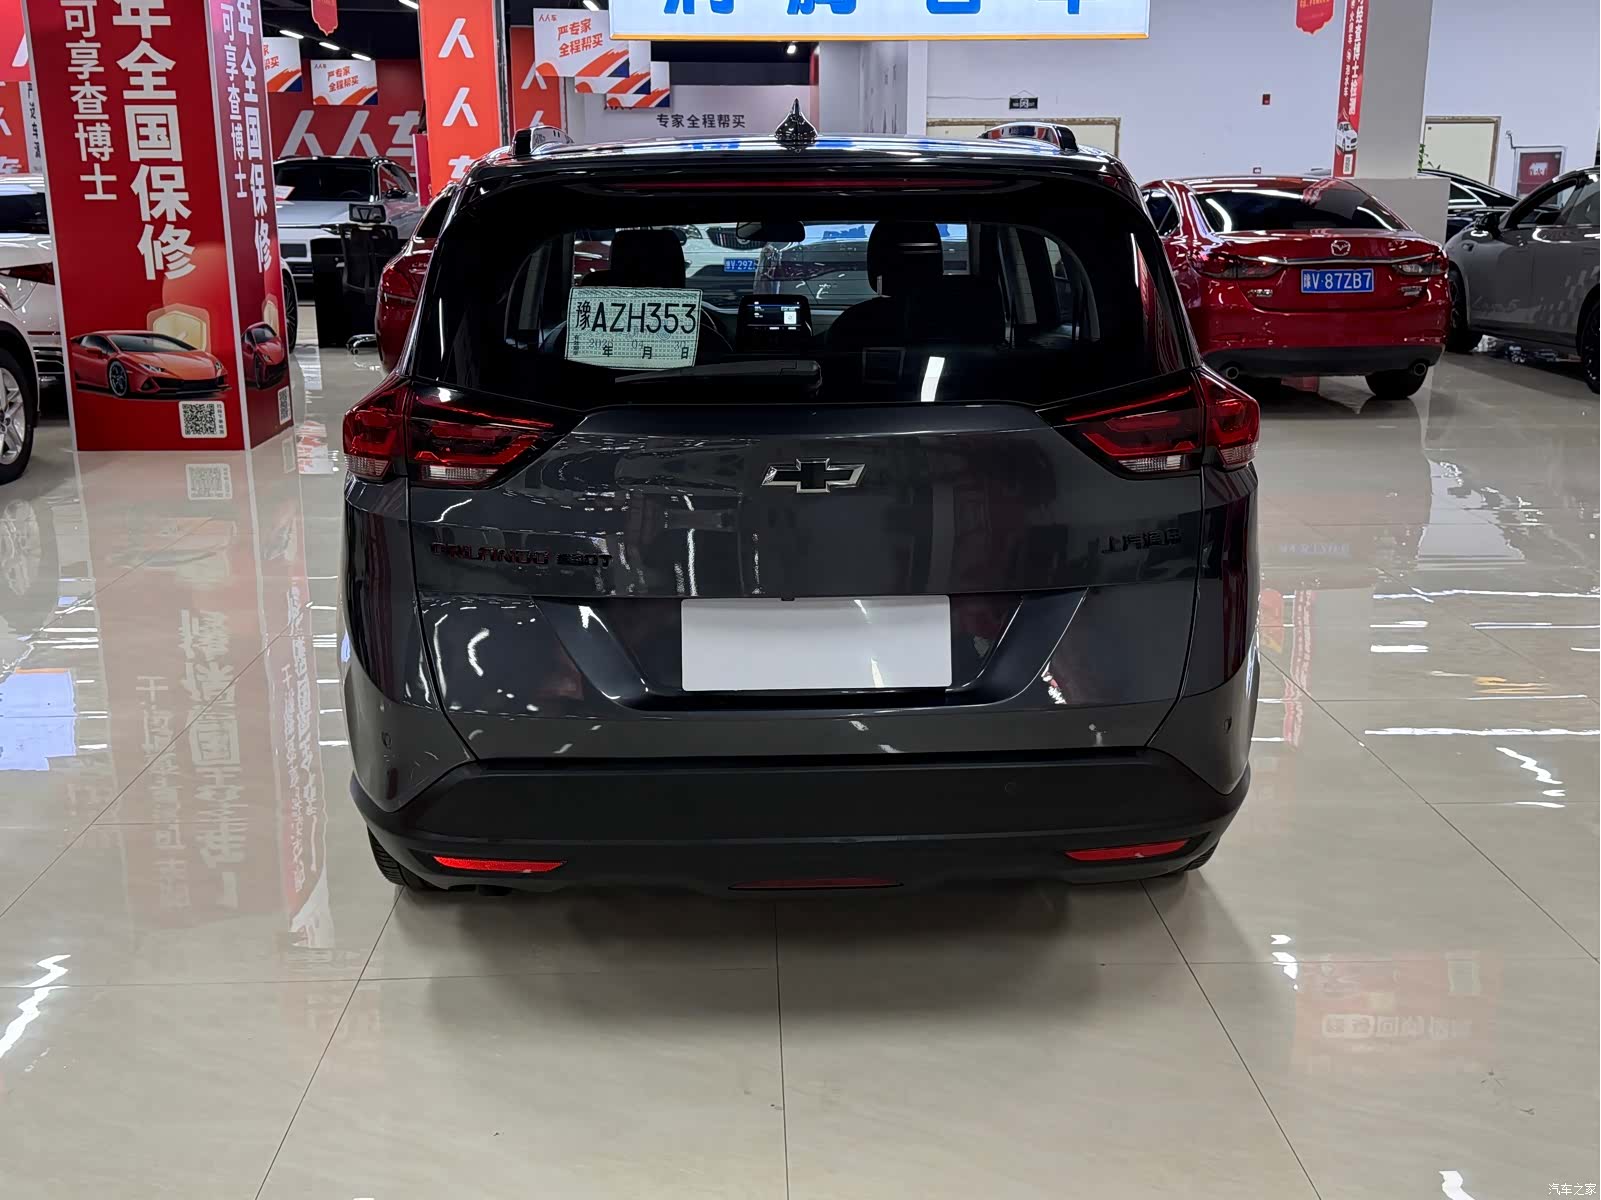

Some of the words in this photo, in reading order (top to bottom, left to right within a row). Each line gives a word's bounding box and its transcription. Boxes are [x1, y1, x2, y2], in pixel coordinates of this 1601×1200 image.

[538, 14, 558, 22] 人人车
[557, 18, 592, 40] 严专家
[558, 33, 604, 58] 全程帮买
[327, 66, 351, 82] 严专家
[328, 75, 359, 93] 全程帮买
[60, 0, 118, 201] 可享查博士
[220, 2, 248, 198] 可享查博士
[656, 113, 746, 129] 专家全程帮买
[112, 0, 196, 280] 年全国保修
[237, 0, 272, 273] 年全国保修
[575, 300, 697, 334] 豫AZH353
[602, 345, 613, 358] 年
[641, 346, 653, 359] 月
[680, 346, 689, 360] 日
